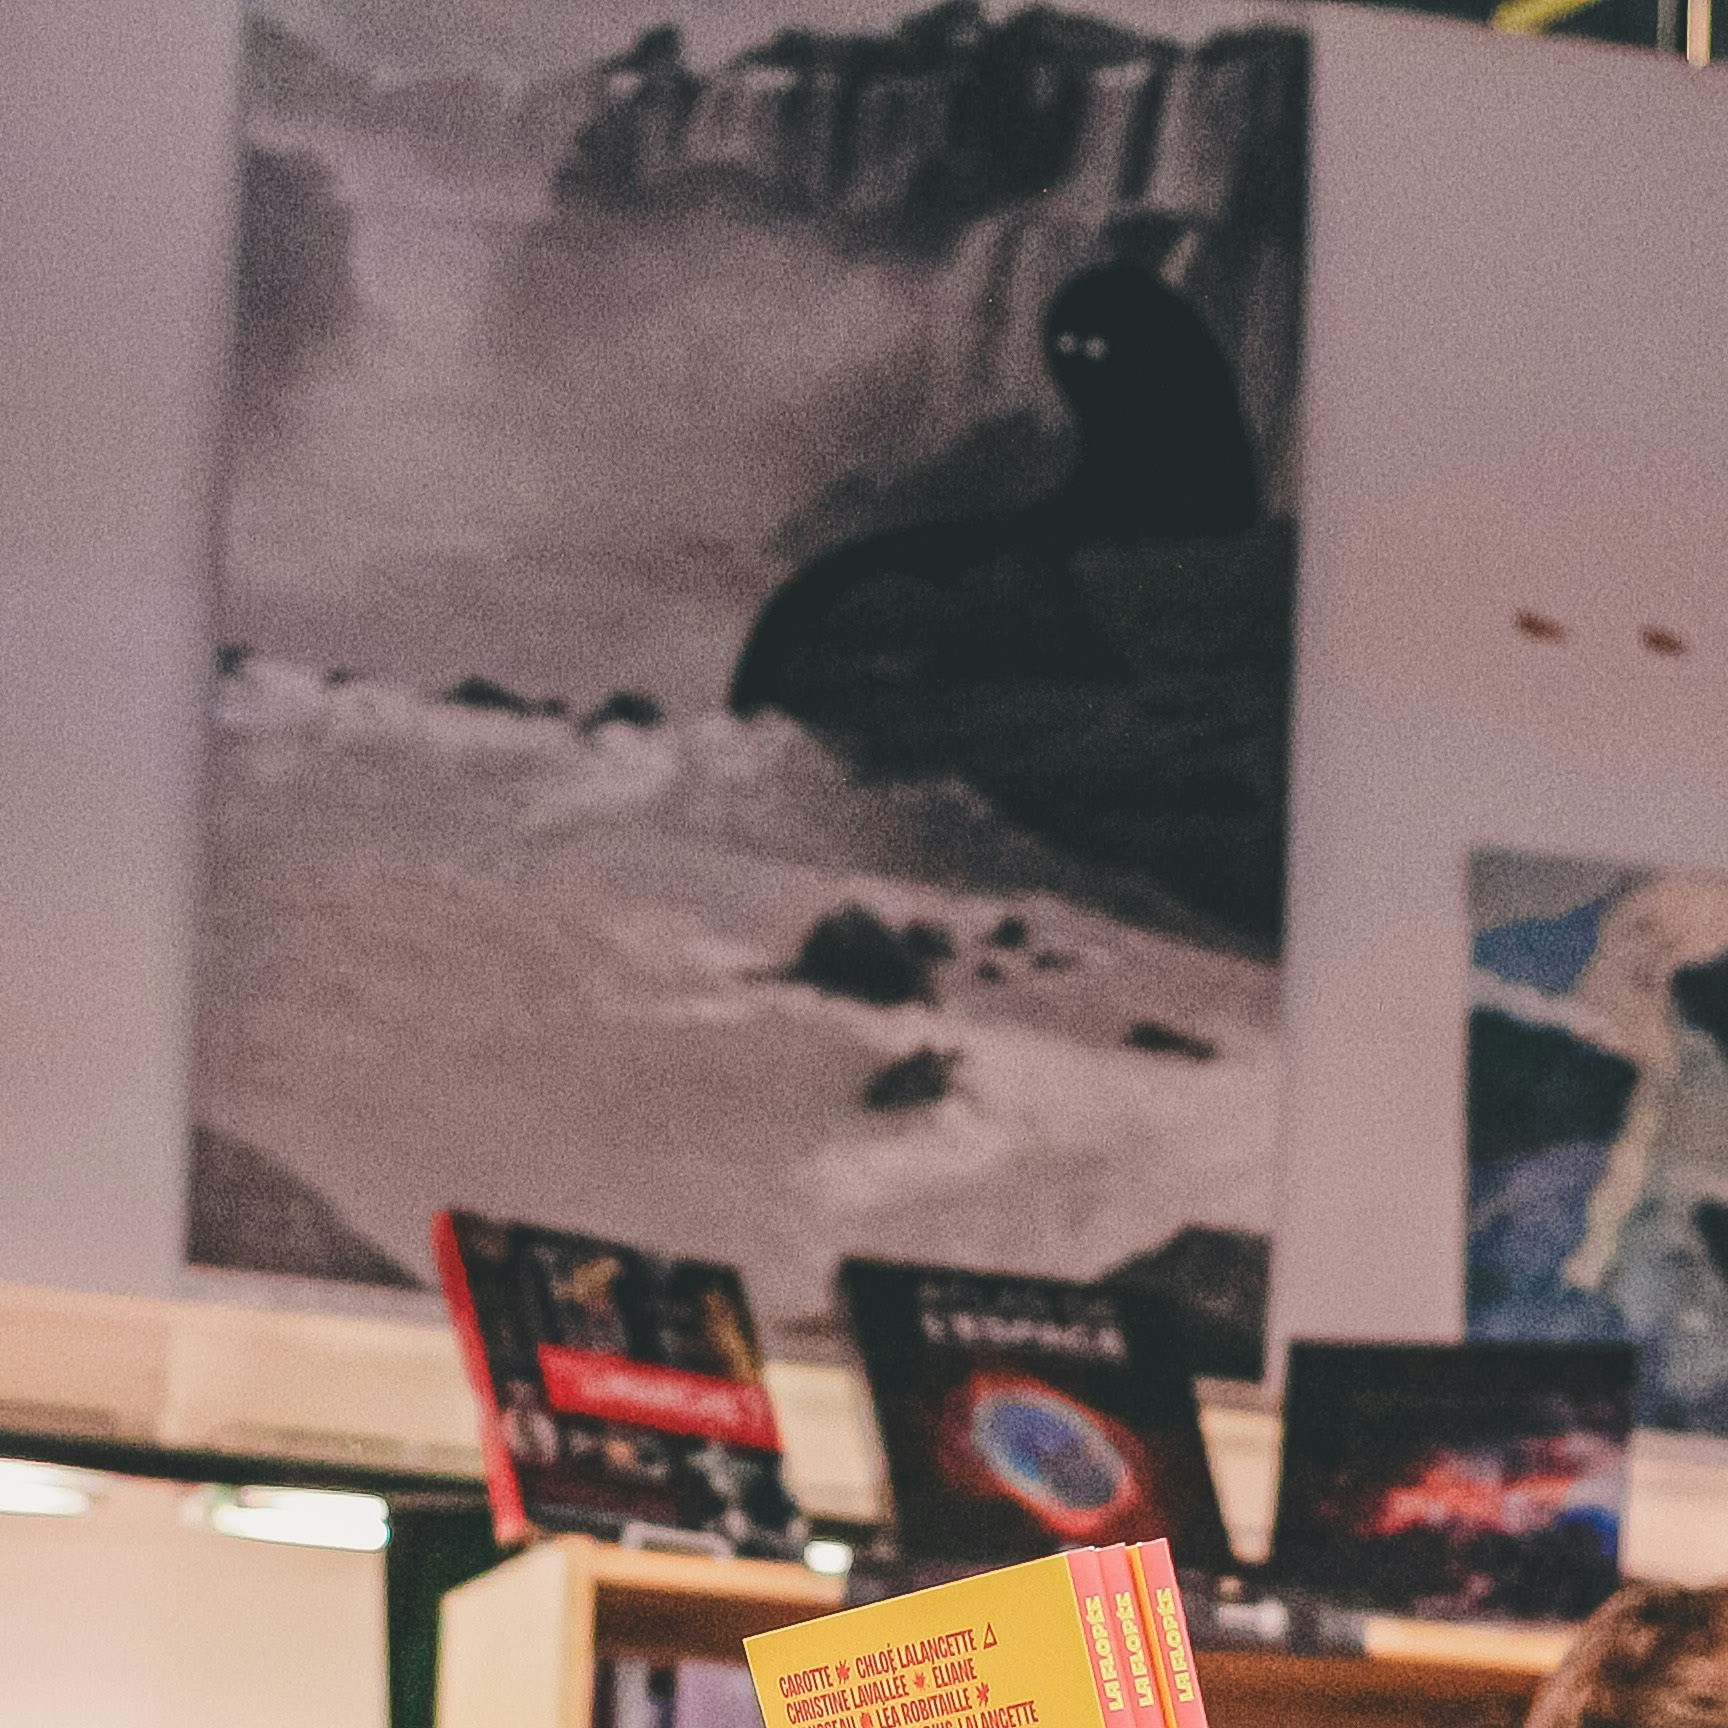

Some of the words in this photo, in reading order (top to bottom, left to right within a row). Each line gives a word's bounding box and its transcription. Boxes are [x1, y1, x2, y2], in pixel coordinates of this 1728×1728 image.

[1085, 1595, 1118, 1681] FLOPÉE
[1115, 1591, 1148, 1677] FLOPÉE
[1156, 1587, 1188, 1672] FLOPÉE
[779, 1665, 834, 1698] CAROTTE
[855, 1643, 897, 1679] CHLOÉ
[898, 1629, 977, 1668] LALANCETTE
[1104, 1680, 1125, 1711] LA
[1133, 1676, 1155, 1707] LA
[1174, 1671, 1195, 1702] LA
[786, 1690, 851, 1724] CHRISTINE
[902, 1687, 973, 1722] ROBITAILLE
